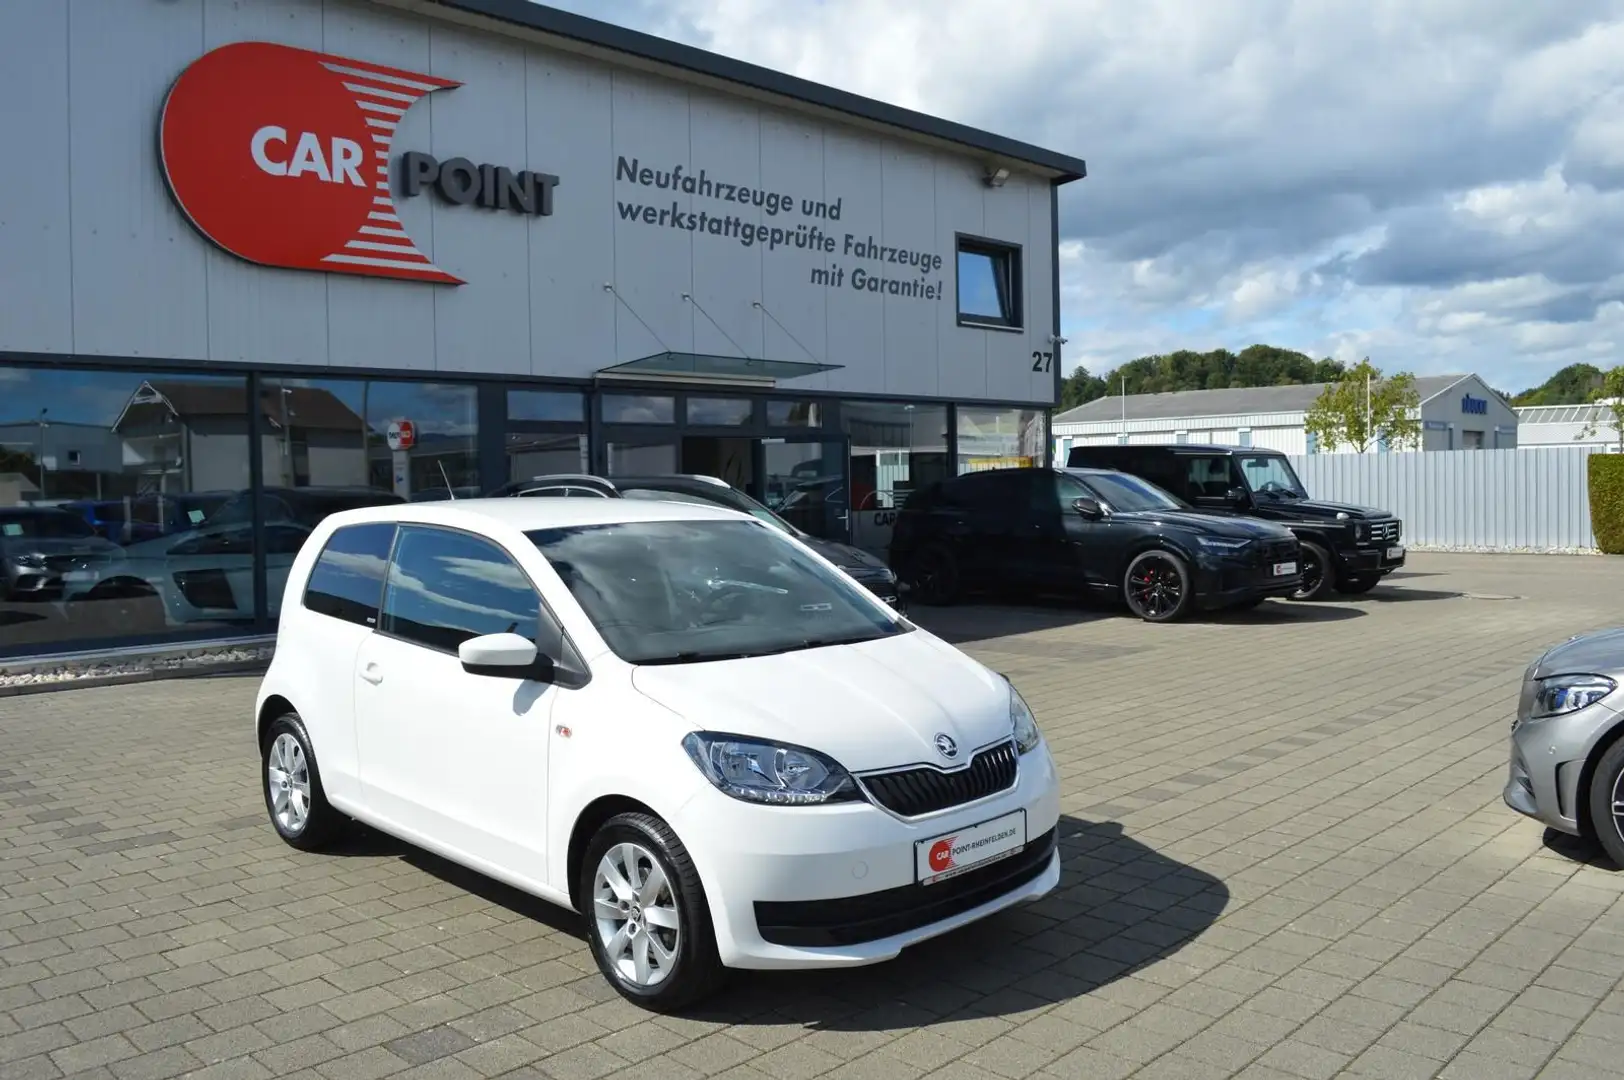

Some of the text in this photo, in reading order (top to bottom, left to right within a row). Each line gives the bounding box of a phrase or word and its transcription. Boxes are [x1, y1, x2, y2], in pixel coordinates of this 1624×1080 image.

[250, 125, 560, 217] CAR POINT
[616, 155, 842, 221] Neufahrzeuge und
[617, 201, 942, 274] werkstattgeprüfte Fahrzeuge
[810, 263, 943, 301] mit Garantie!
[1032, 351, 1053, 372] 27
[936, 827, 1017, 861] CAR POINT-RHEINFELDEN.DE
